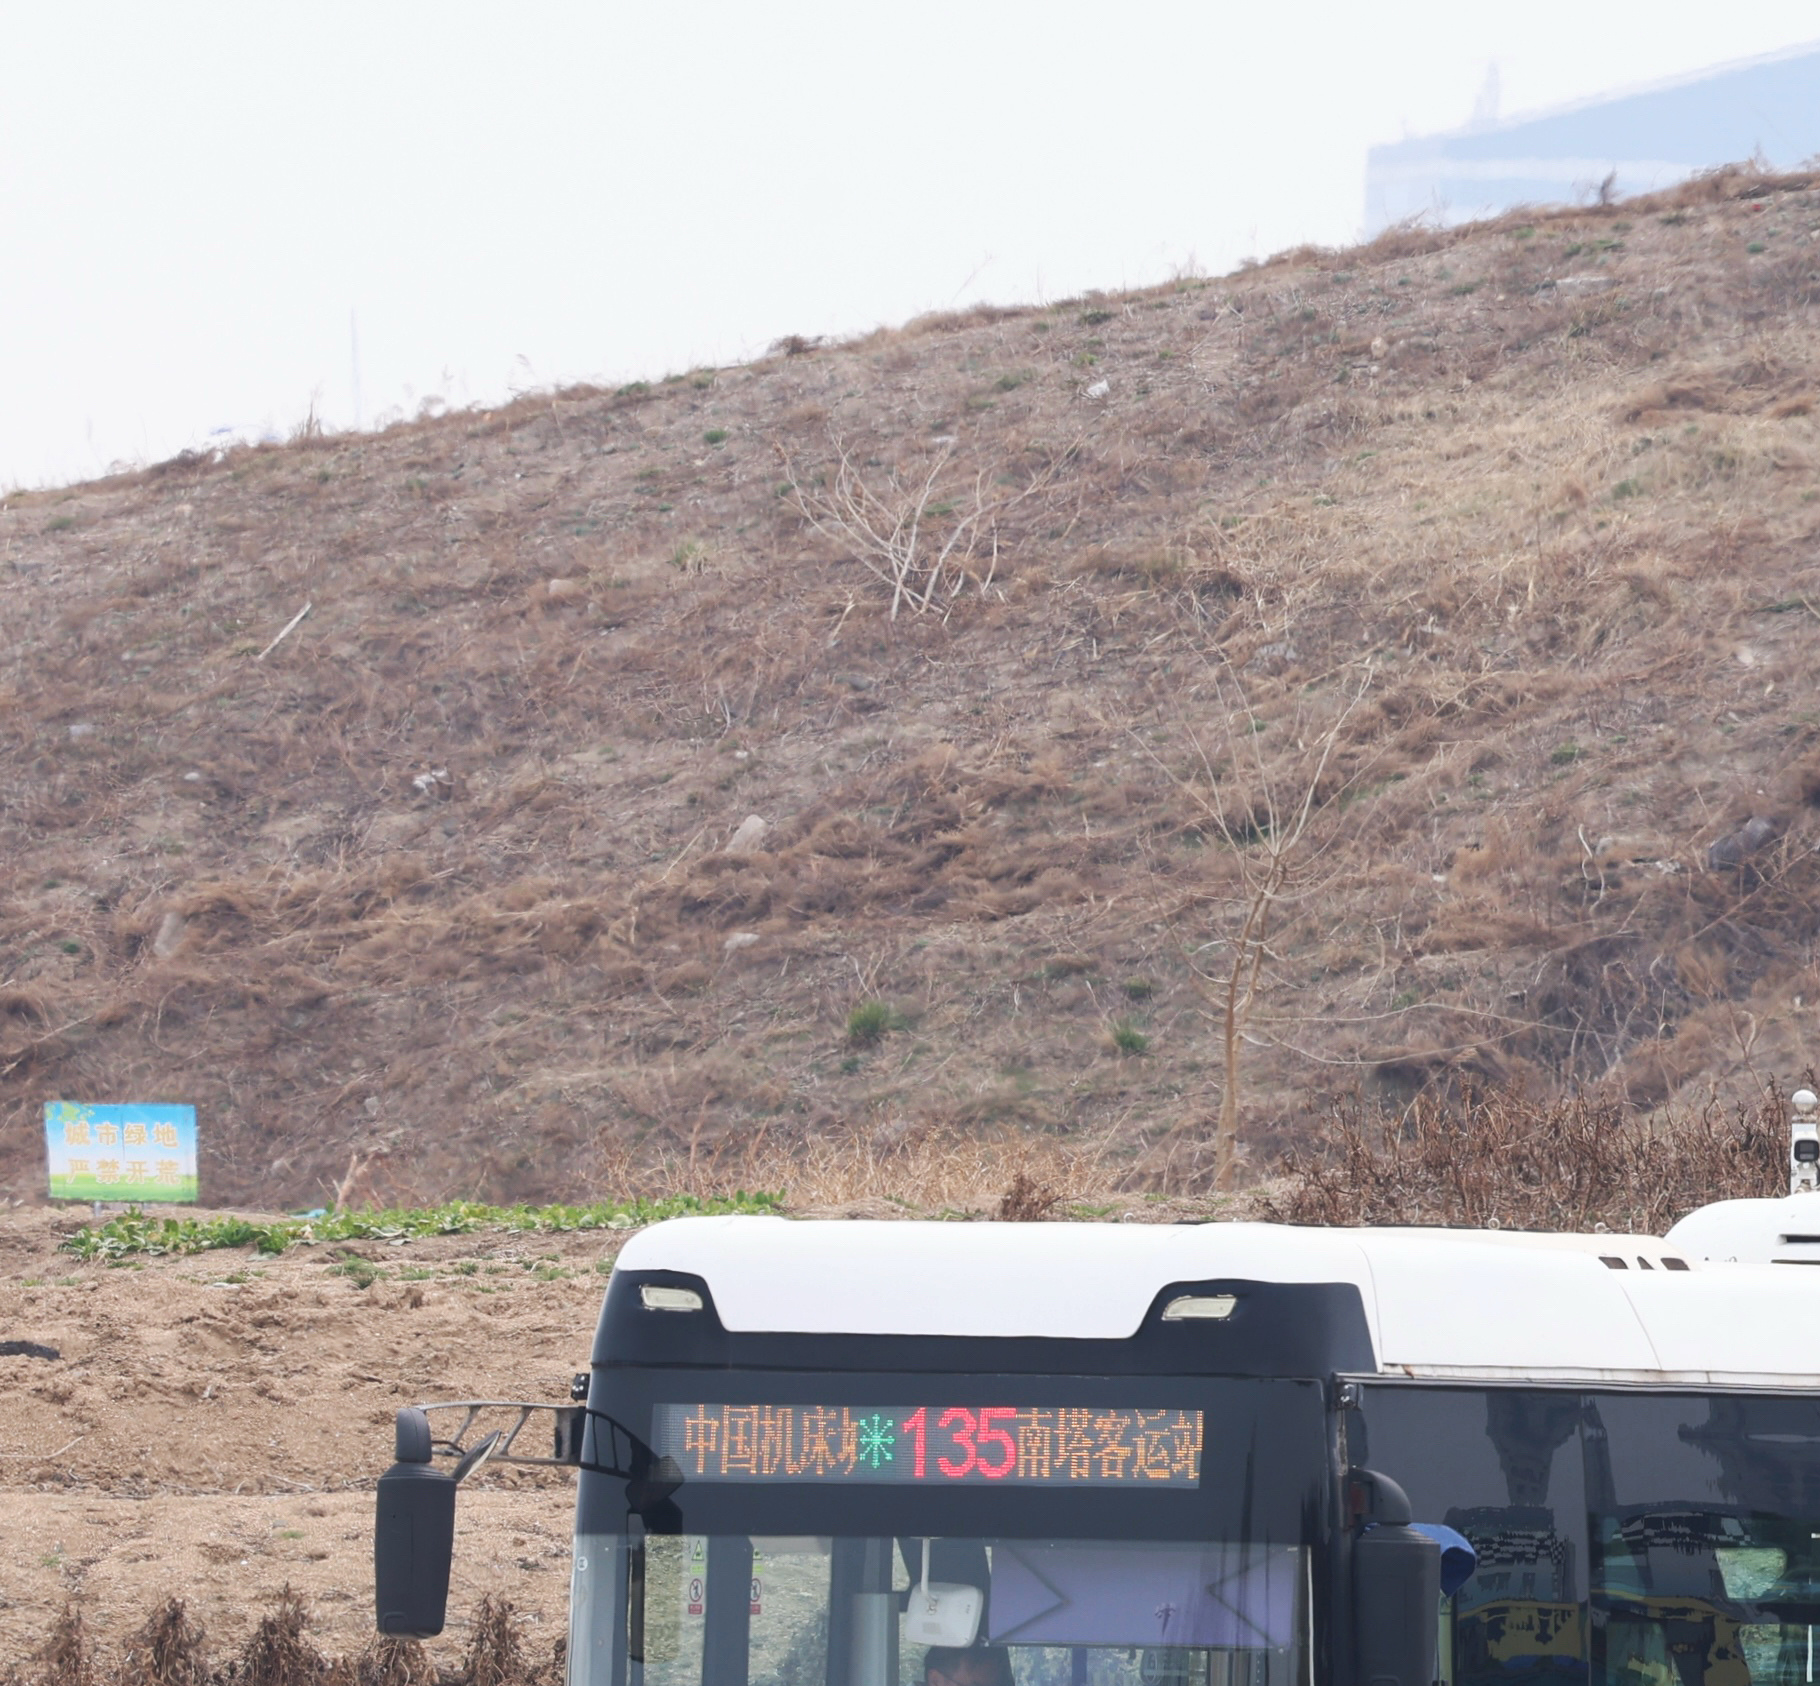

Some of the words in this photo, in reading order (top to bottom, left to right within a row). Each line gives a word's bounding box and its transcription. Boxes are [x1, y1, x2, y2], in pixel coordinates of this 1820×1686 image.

[64, 1121, 179, 1148] 城市绿地
[66, 1158, 181, 1185] 严禁开荒
[902, 1405, 1017, 1479] 135
